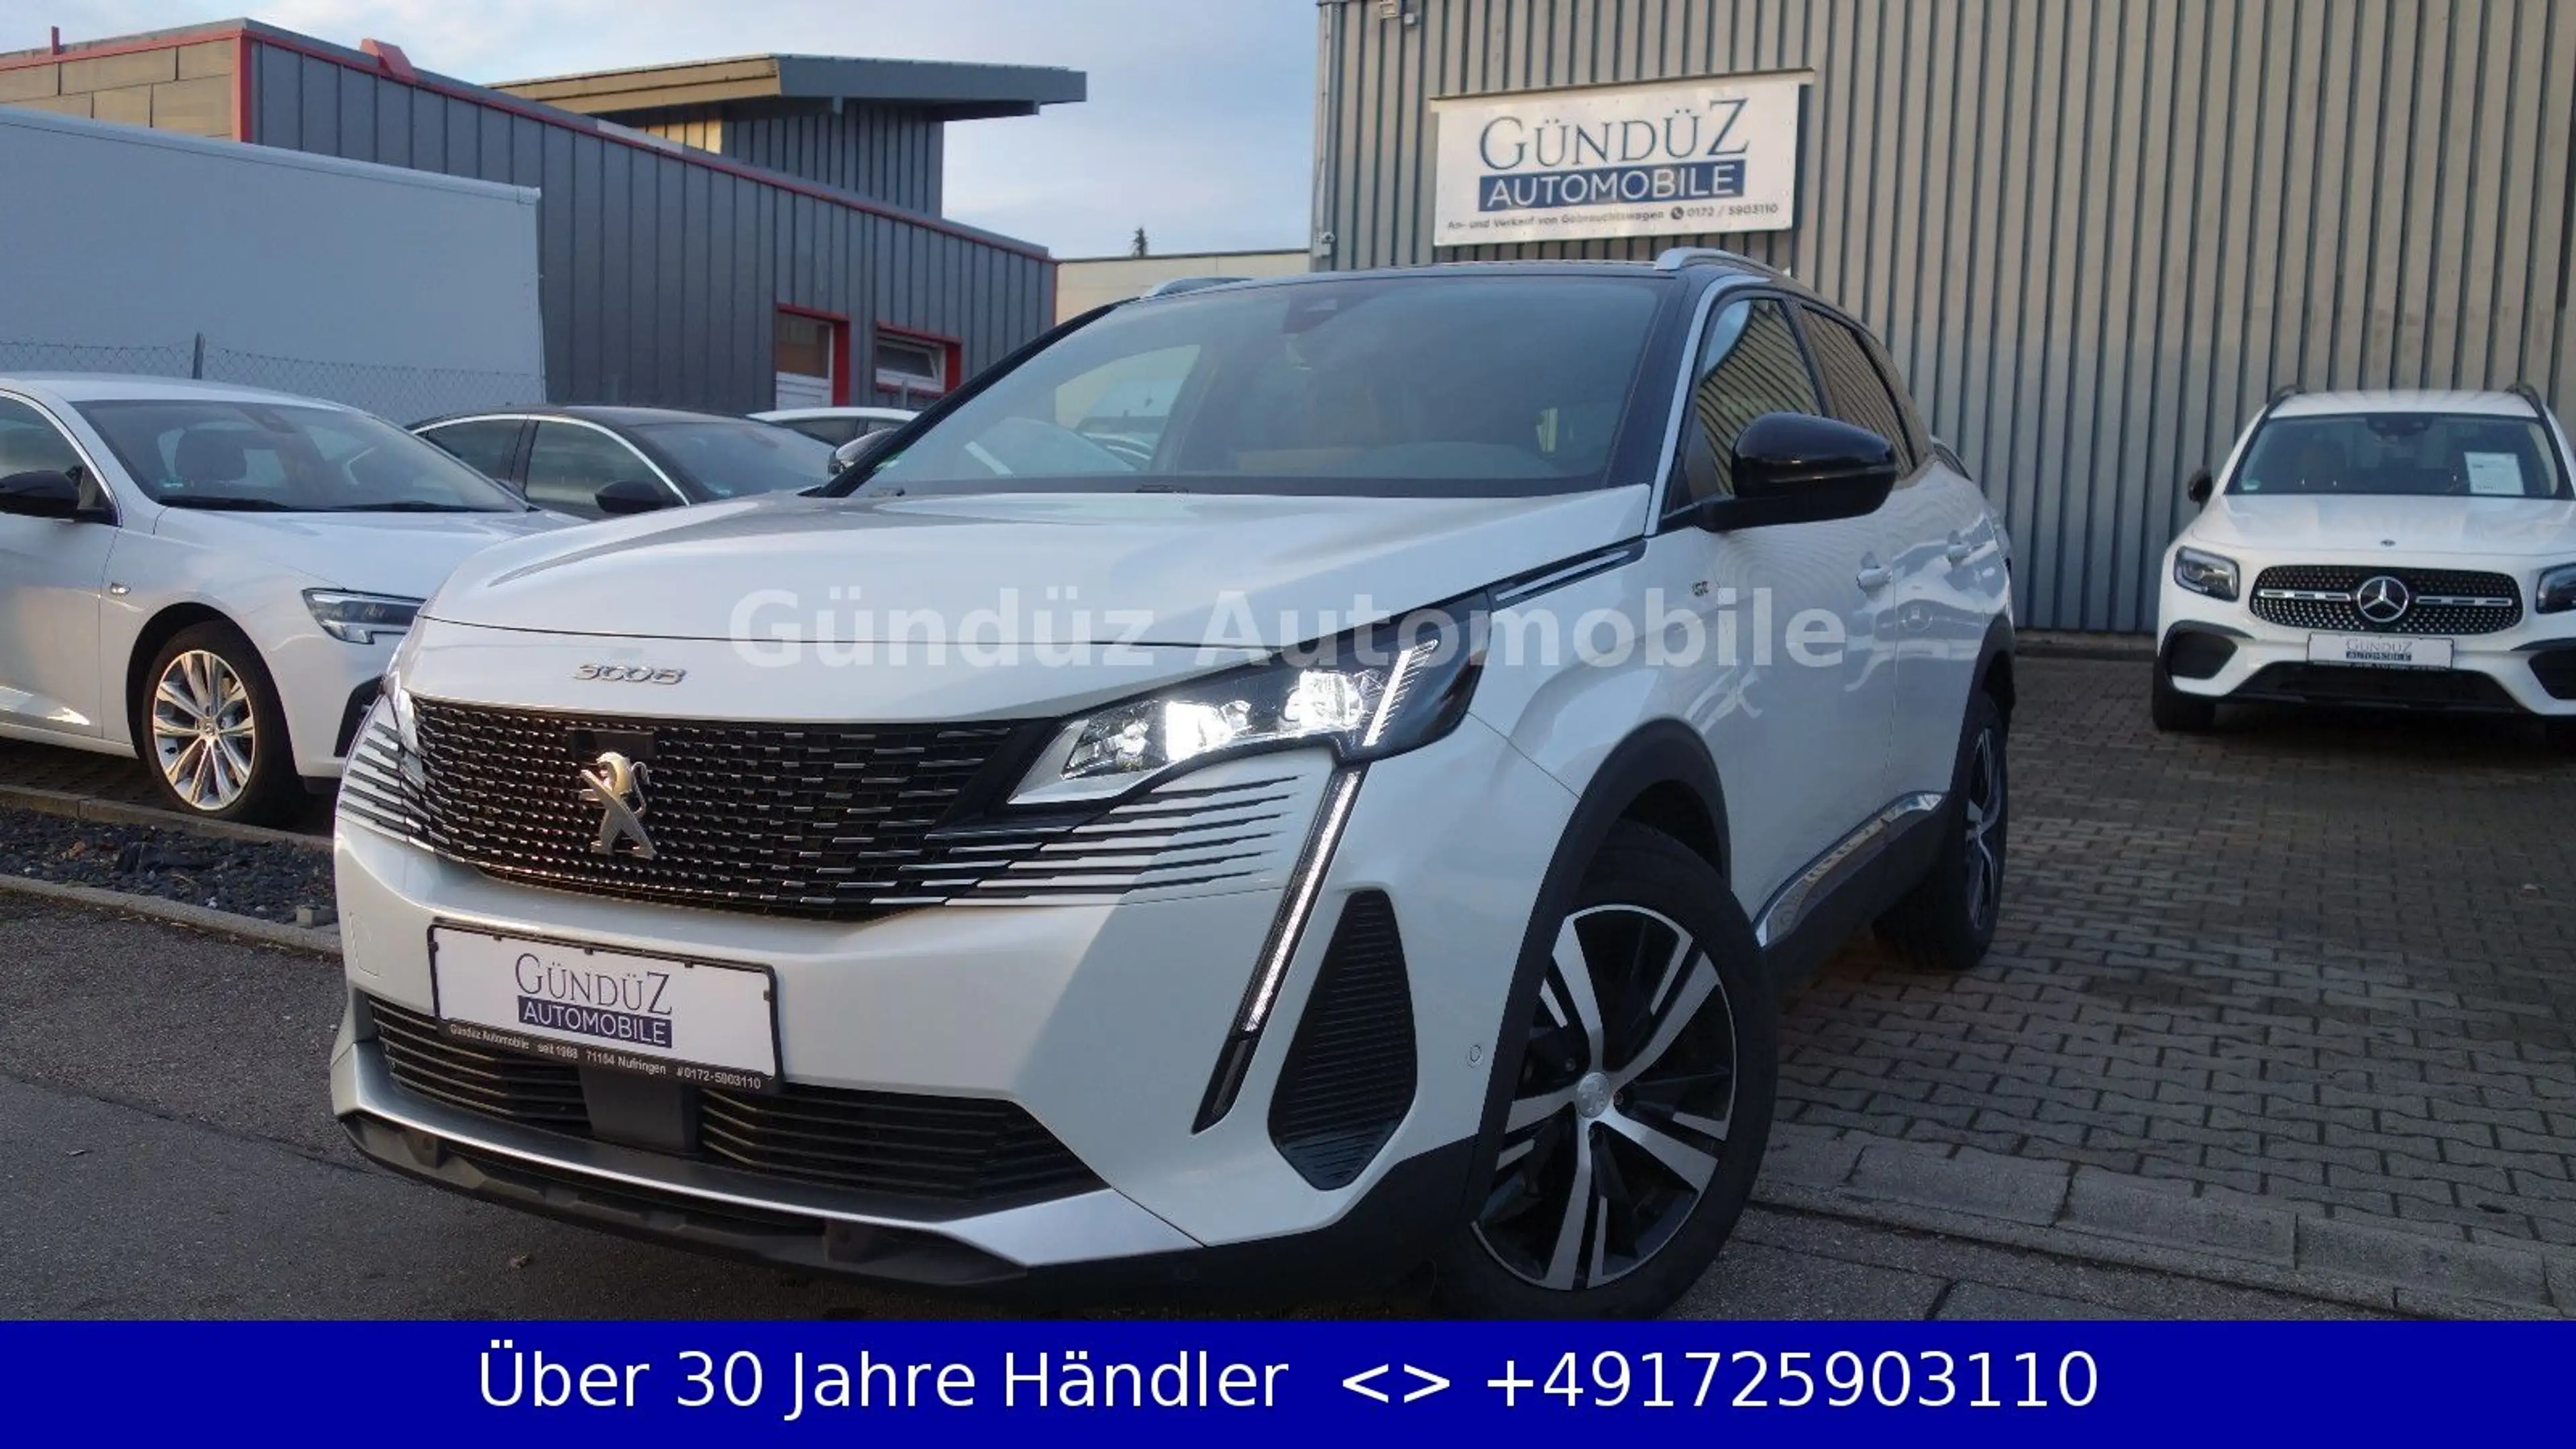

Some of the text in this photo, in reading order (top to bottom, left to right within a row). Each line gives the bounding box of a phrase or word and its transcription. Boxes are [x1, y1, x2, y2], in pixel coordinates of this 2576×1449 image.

[1479, 98, 1750, 171] GÜNDÜZ
[1487, 164, 1735, 207] AUTOMOBILE
[573, 663, 687, 686] 3008
[515, 953, 673, 1016] GÜNDÜZ
[523, 1004, 667, 1044] AUTOMOBILE
[537, 1043, 555, 1055] seit
[617, 1056, 666, 1075] Nufringen
